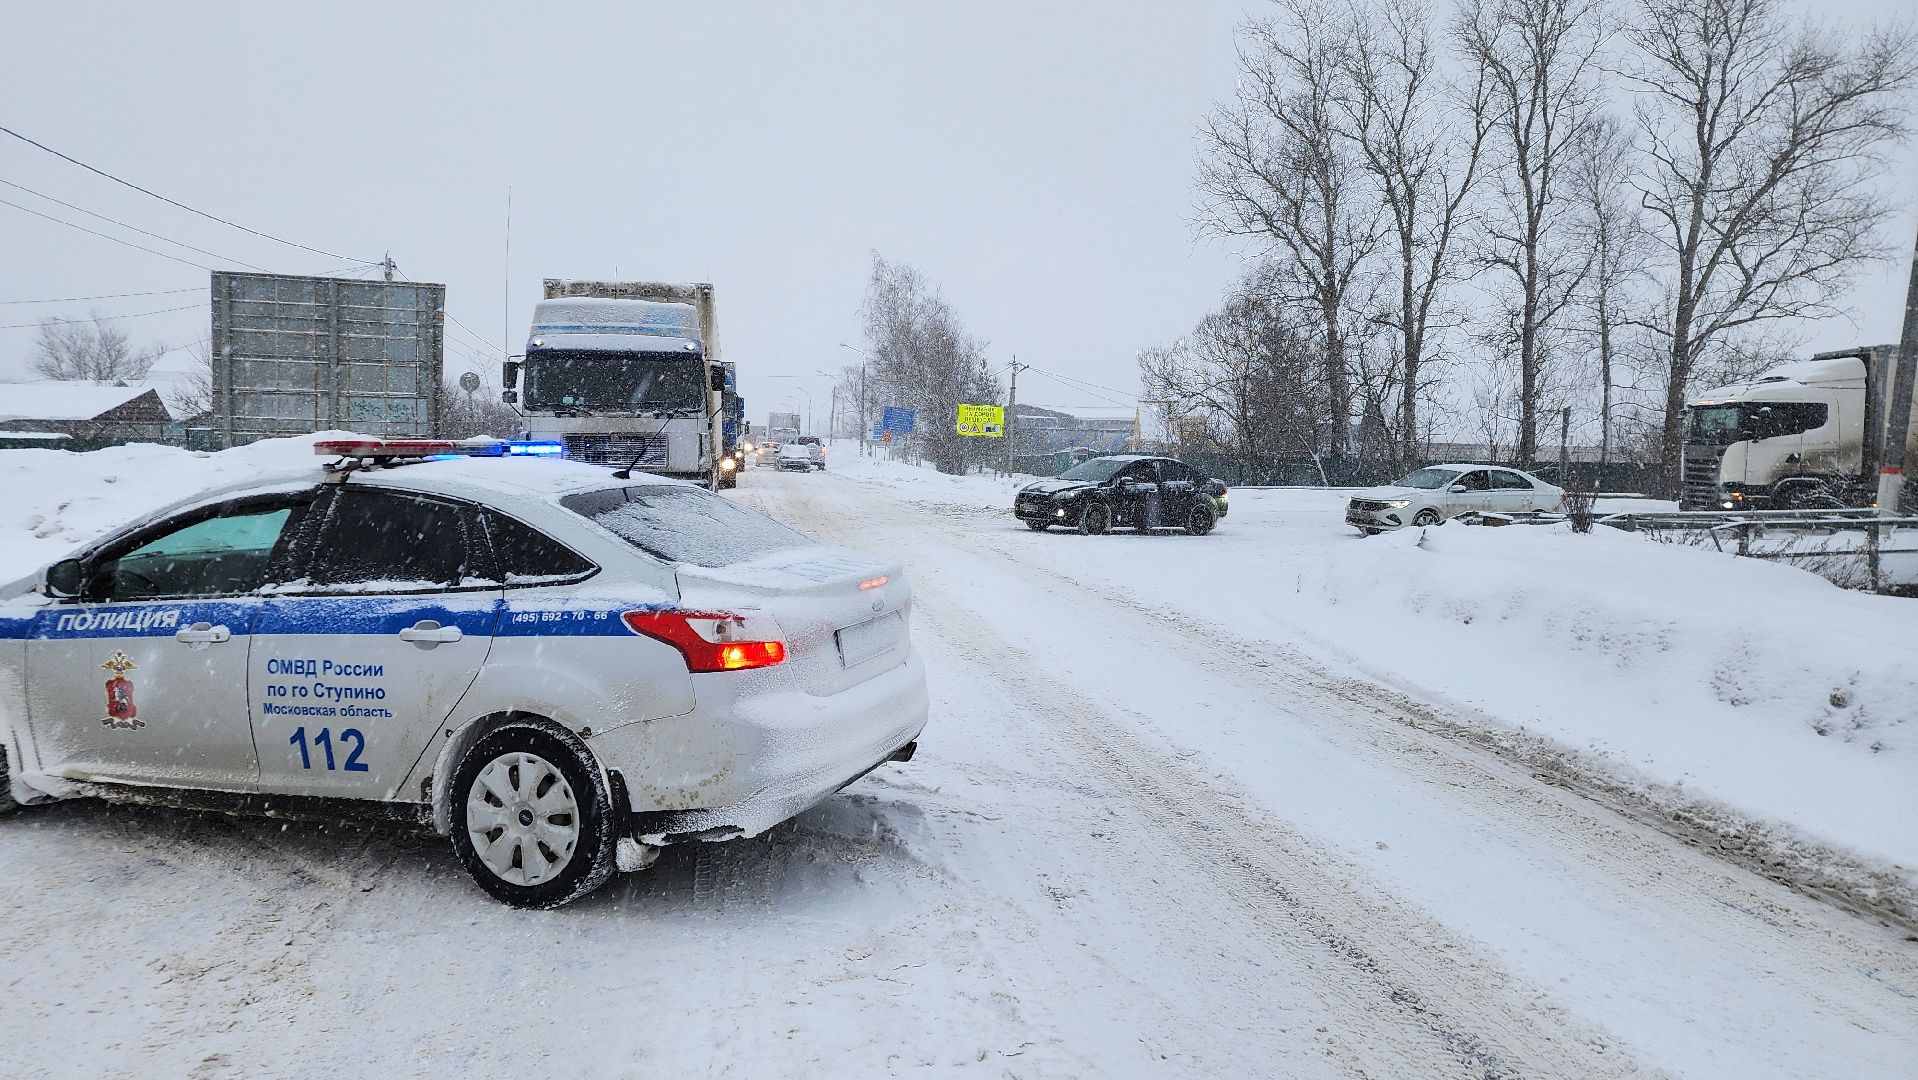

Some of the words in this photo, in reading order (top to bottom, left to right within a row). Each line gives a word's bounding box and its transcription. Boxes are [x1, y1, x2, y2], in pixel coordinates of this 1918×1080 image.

[56, 609, 181, 632] ПОЛИЦИЯ
[512, 613, 539, 624] (495)
[541, 612, 562, 622] 692
[571, 612, 585, 621] 70
[593, 611, 608, 620] 66
[267, 658, 318, 678] ОМВД
[322, 659, 384, 677] России
[267, 685, 287, 697] по
[292, 685, 308, 698] го
[313, 682, 386, 703] Ступино
[263, 702, 336, 716] Московская
[339, 704, 393, 719] область
[289, 726, 369, 773] 112
